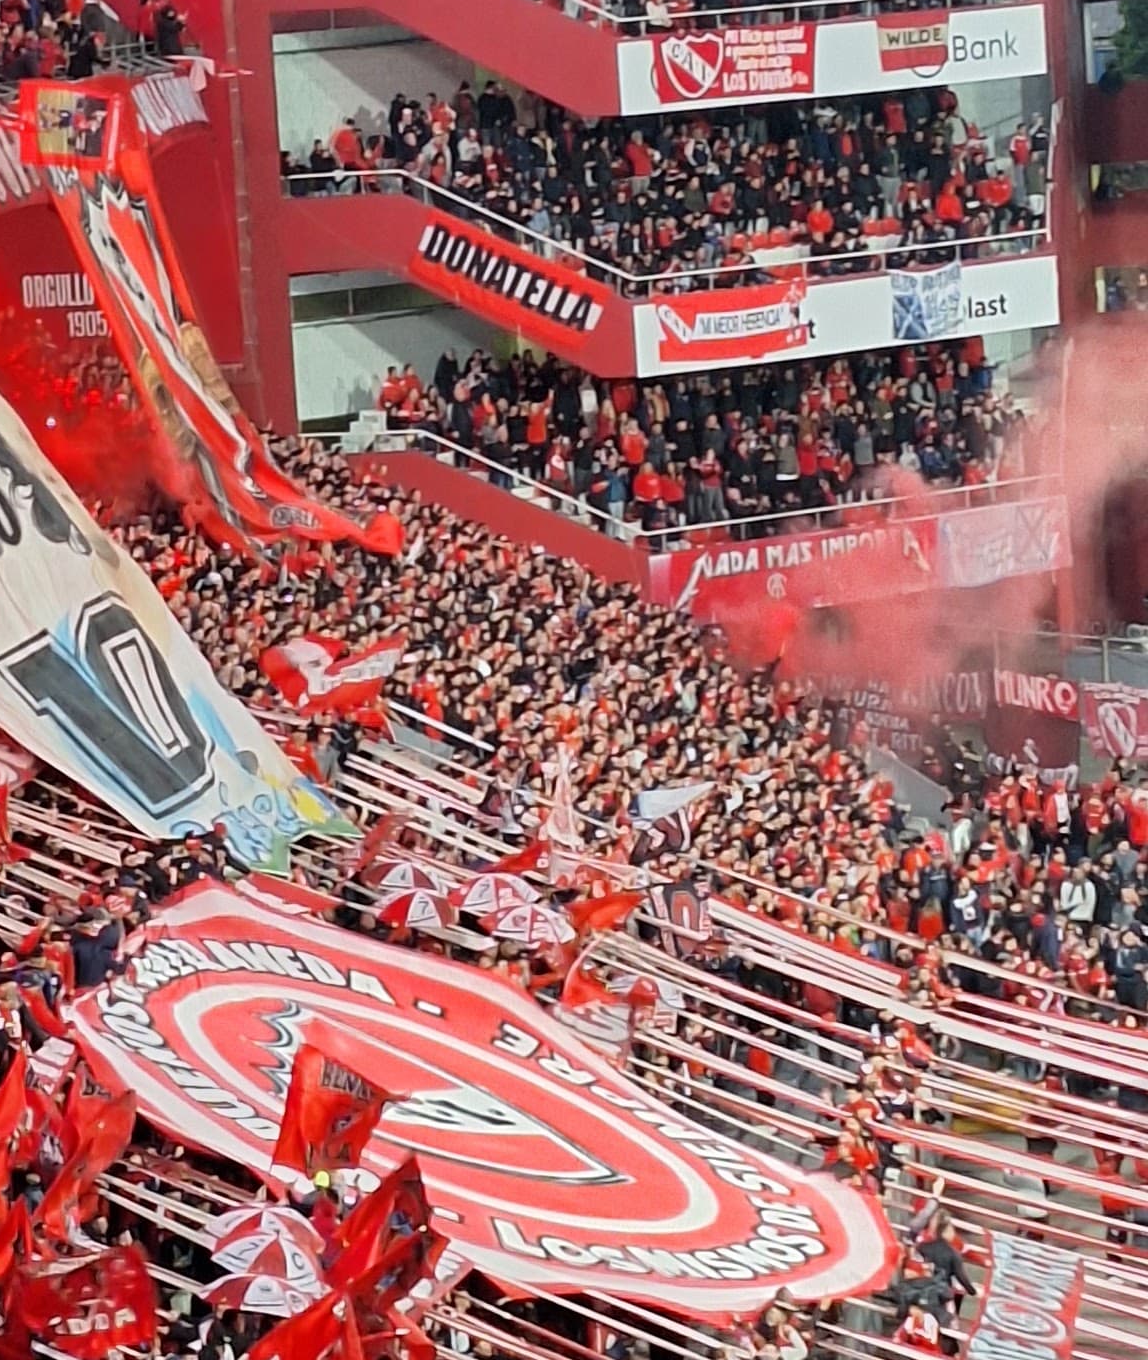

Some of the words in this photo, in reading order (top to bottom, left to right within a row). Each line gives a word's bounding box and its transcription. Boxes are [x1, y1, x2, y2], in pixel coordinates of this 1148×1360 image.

[886, 27, 944, 46] WILDE
[952, 29, 1019, 62] Bank
[423, 223, 595, 332] DONATELLA
[766, 540, 813, 568] MAS
[821, 527, 930, 572] IMPORA
[994, 668, 1078, 714] MUNRO
[491, 1023, 793, 1198] SIEMPRE
[492, 1215, 650, 1275] LOS
[639, 1220, 828, 1280] MISMOS
